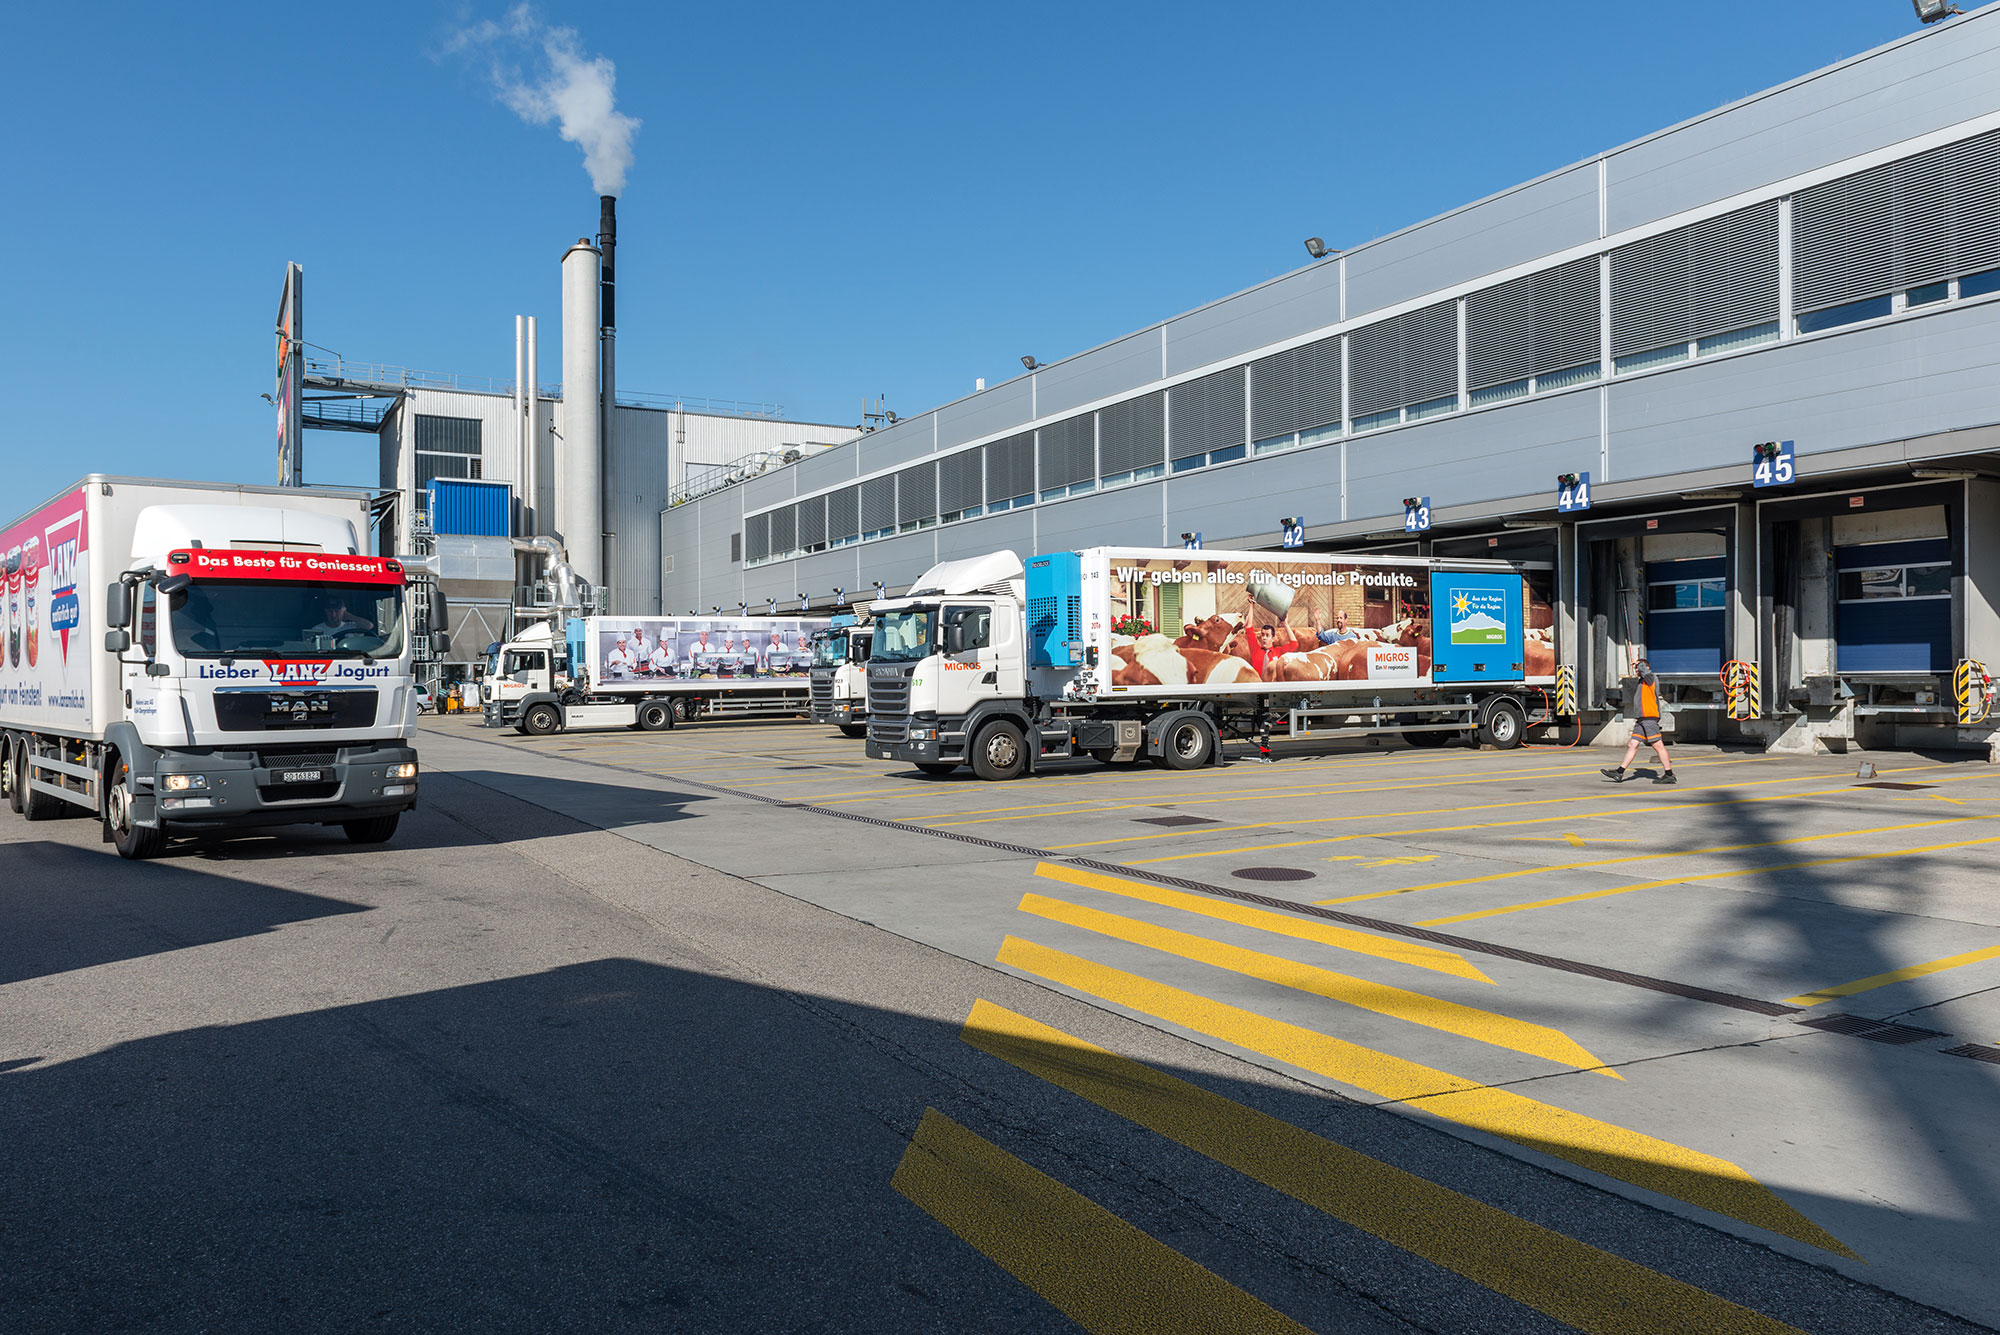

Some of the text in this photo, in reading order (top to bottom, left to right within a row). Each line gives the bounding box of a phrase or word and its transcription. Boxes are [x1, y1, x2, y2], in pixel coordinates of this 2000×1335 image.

[1755, 454, 1793, 484] 45
[1559, 483, 1589, 510] 44
[1406, 506, 1429, 530] 43
[1284, 525, 1303, 546] 42
[50, 538, 76, 595] LANZ
[198, 555, 383, 573] Das Beste für Geniesser!
[1116, 566, 1418, 588] Wir geben alles für regionale Produkte.
[944, 662, 981, 671] MIGROS
[1376, 653, 1410, 662] MIGROS
[199, 664, 390, 682] Lieber LANZ Jogurt
[271, 701, 329, 712] MAN
